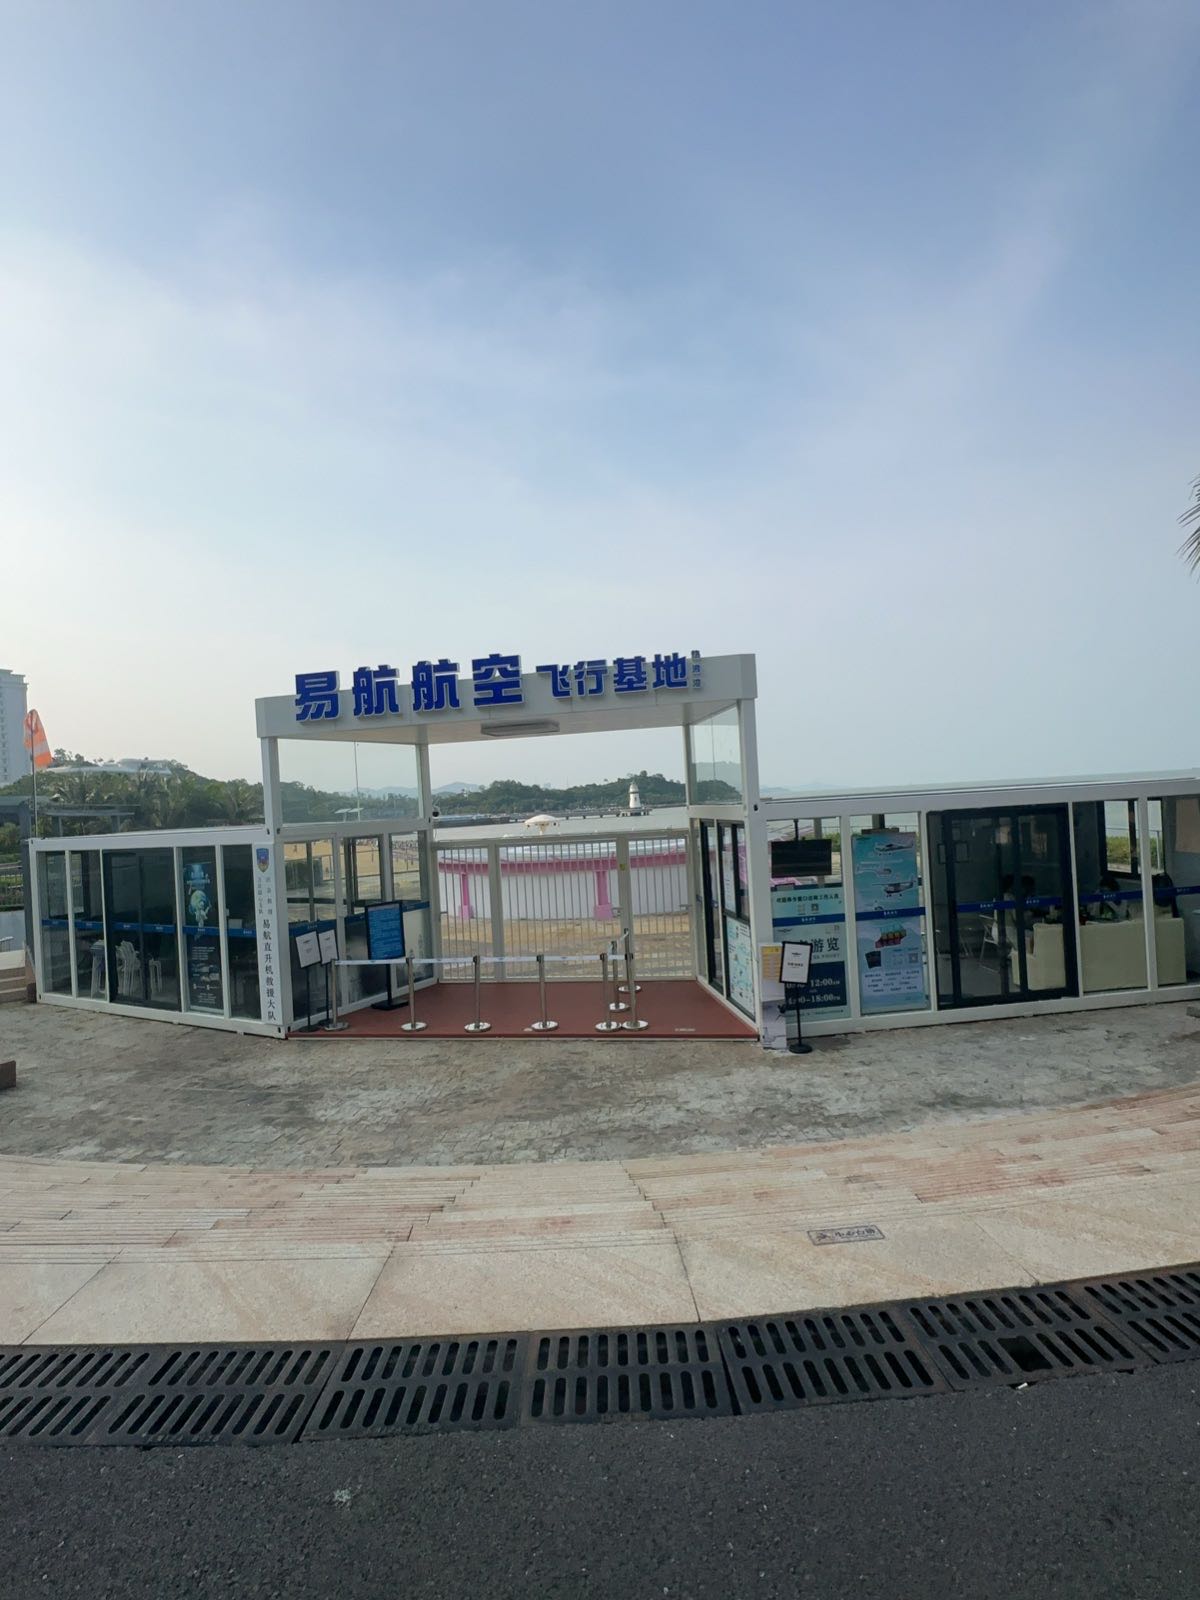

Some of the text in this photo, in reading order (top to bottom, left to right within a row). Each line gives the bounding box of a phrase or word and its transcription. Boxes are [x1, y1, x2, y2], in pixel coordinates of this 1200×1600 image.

[295, 653, 525, 722] 易航航空
[535, 652, 689, 699] 飞行基地
[262, 919, 277, 1021] 易航直升机救援大队
